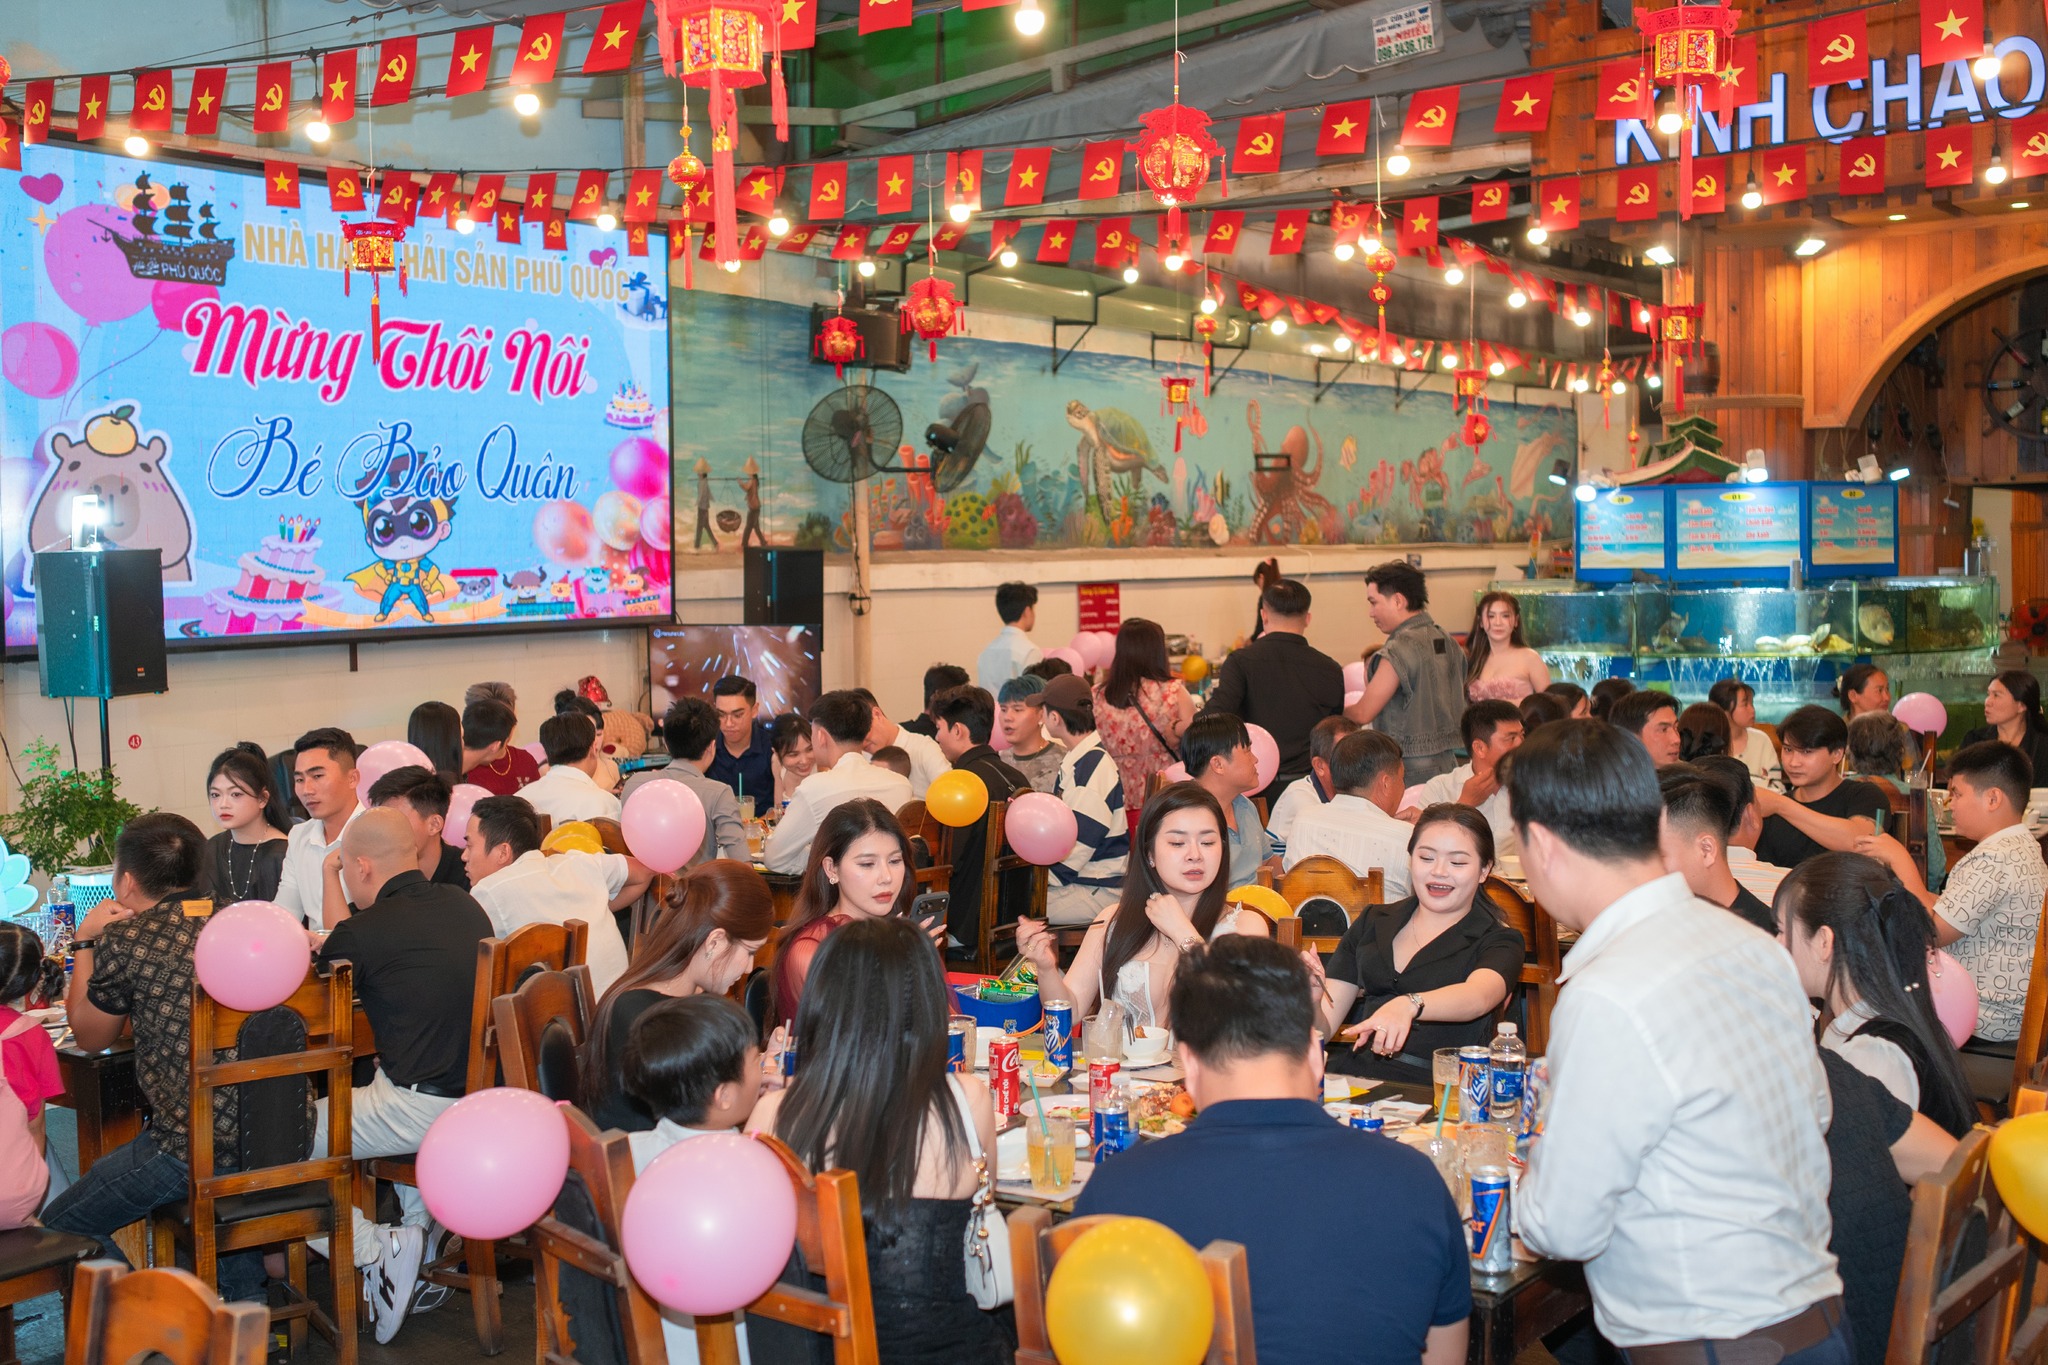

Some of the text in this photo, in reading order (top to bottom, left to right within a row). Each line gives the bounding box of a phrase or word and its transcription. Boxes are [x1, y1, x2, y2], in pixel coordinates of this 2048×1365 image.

[244, 222, 307, 267] NHÀ
[403, 233, 446, 282] HẢI
[456, 240, 507, 290] SẢN
[516, 254, 562, 294] PHÚ
[569, 256, 630, 301] QUỐC
[185, 302, 591, 403] Mừng Thôi Nôi
[208, 415, 580, 504] Bé Bảo Quân
[130, 736, 141, 748] 43
